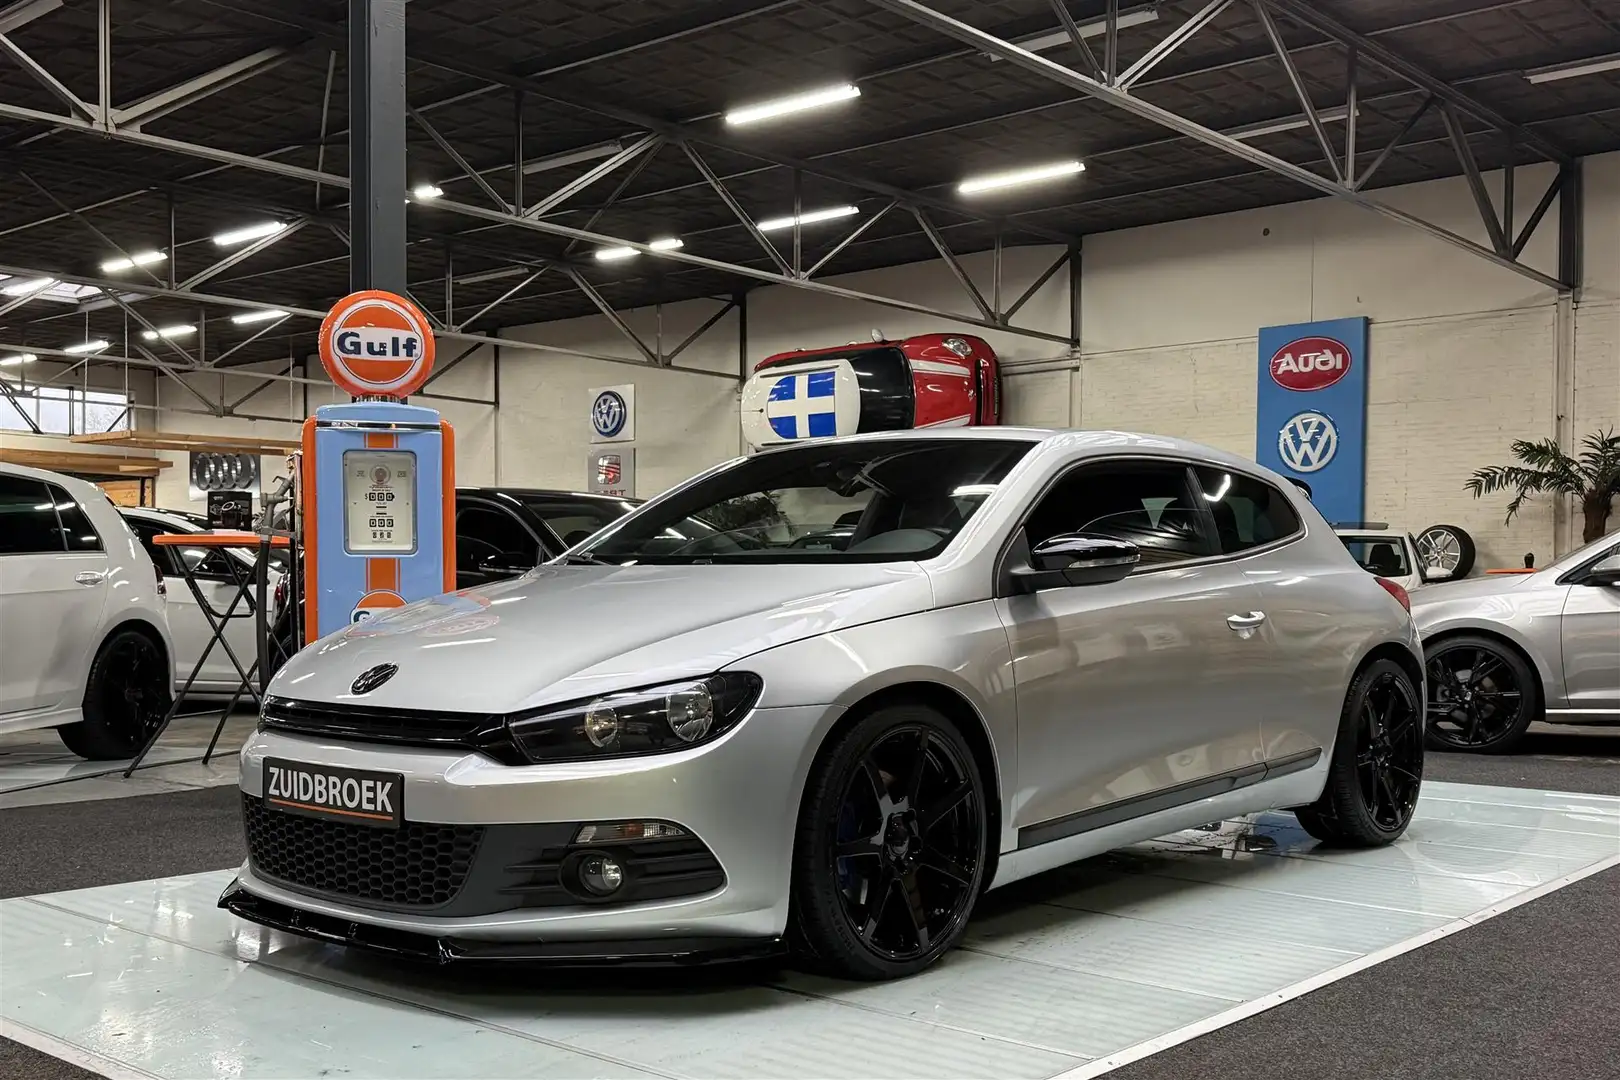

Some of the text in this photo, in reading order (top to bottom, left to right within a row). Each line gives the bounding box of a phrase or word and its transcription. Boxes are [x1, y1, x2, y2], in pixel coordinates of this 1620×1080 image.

[336, 331, 418, 357] Gulf
[1279, 412, 1338, 472] VW
[268, 766, 394, 813] ZUIDBROEK
